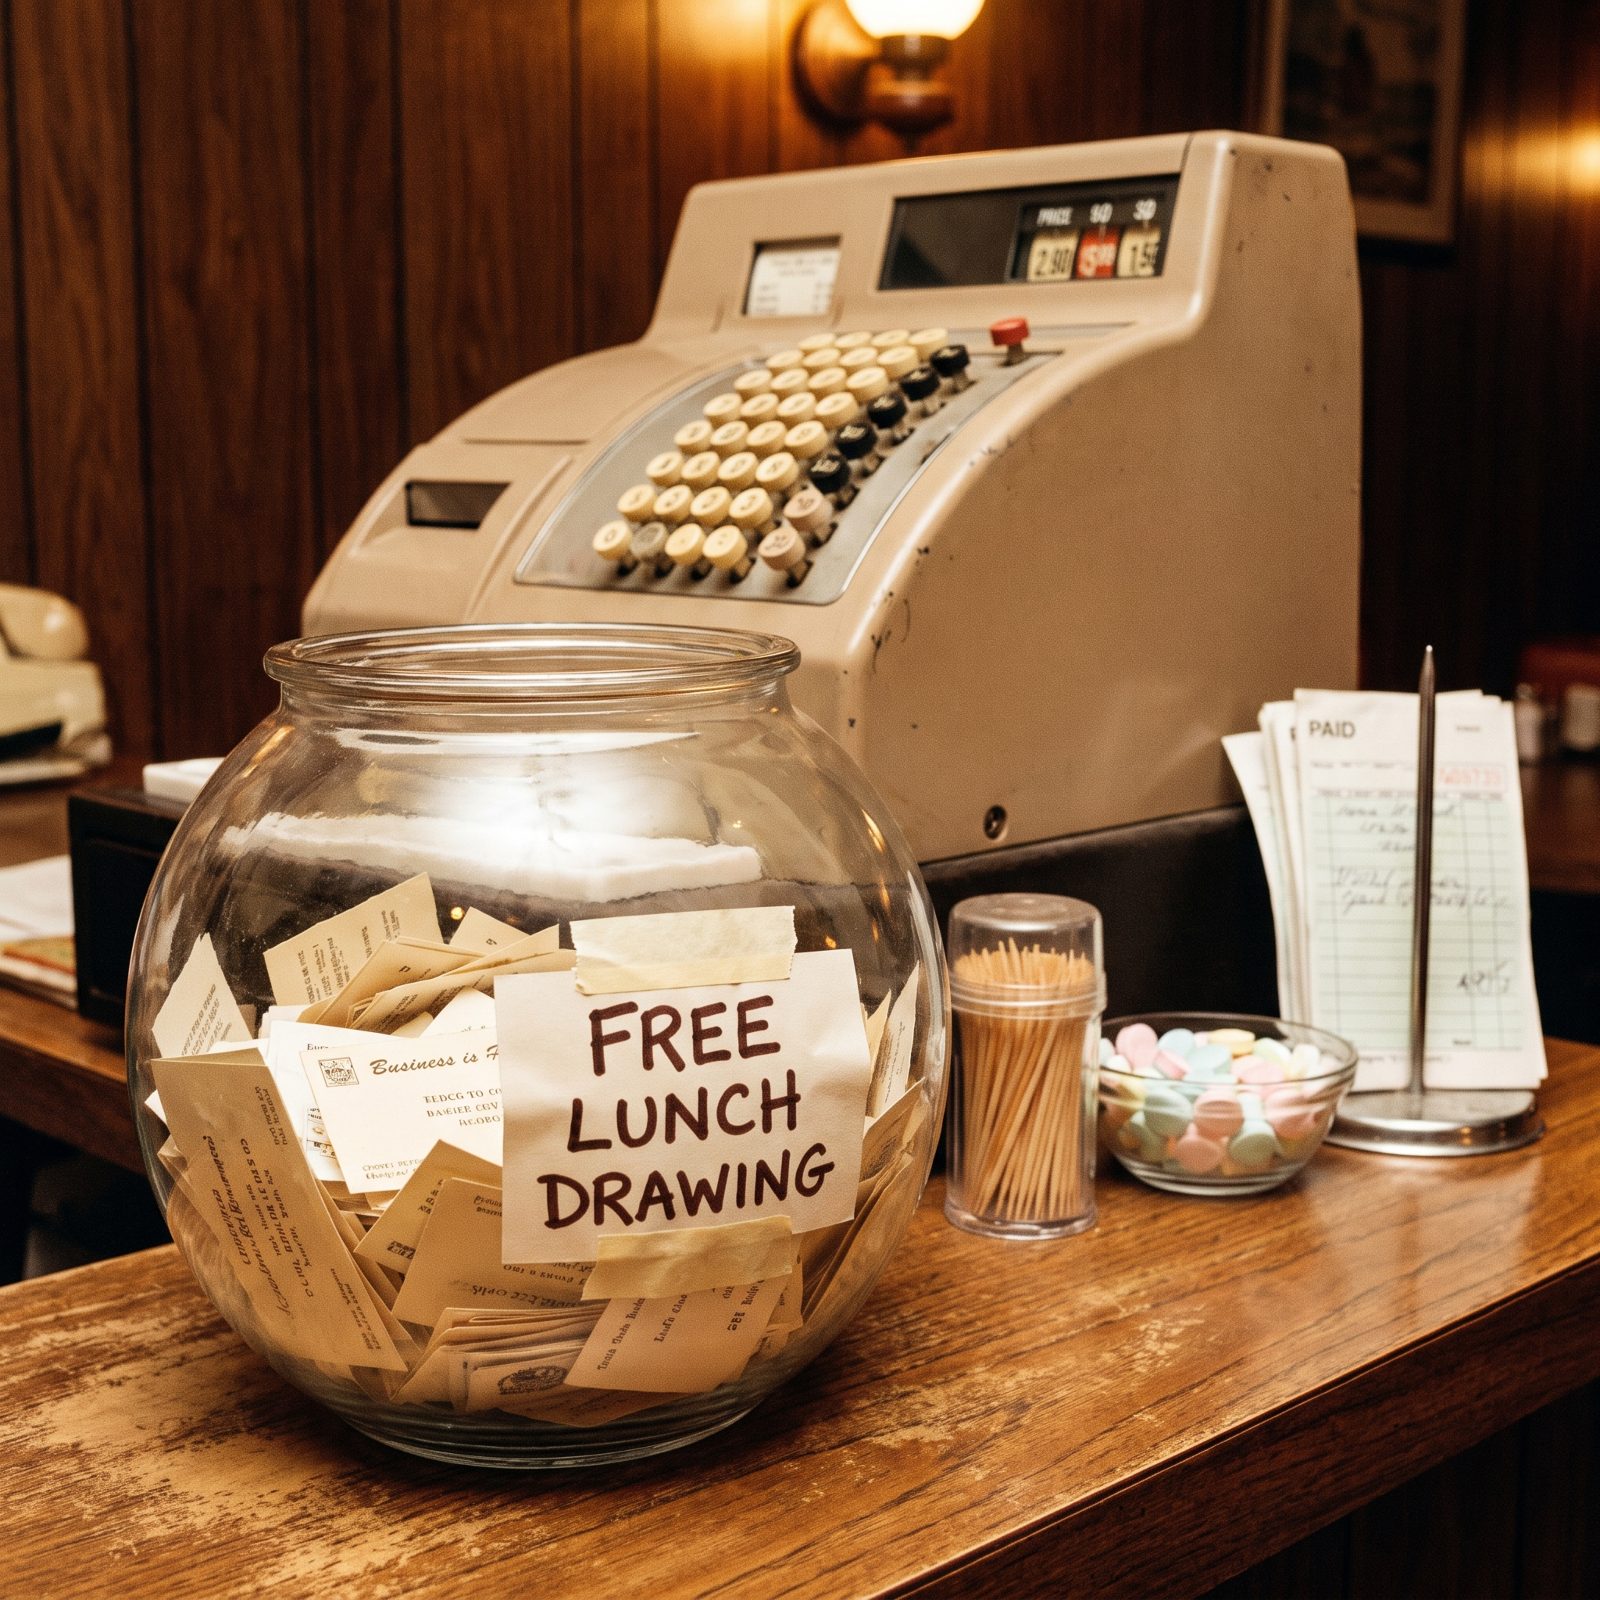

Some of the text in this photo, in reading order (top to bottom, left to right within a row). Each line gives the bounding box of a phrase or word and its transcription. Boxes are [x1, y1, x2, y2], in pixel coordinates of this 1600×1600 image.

[1309, 719, 1356, 739] PAID
[588, 995, 782, 1077] FREE
[369, 1056, 456, 1076] Business
[463, 1052, 479, 1064] is
[466, 1089, 484, 1099] TO
[567, 1069, 801, 1153] LUNCH
[537, 1143, 835, 1230] DRAWING
